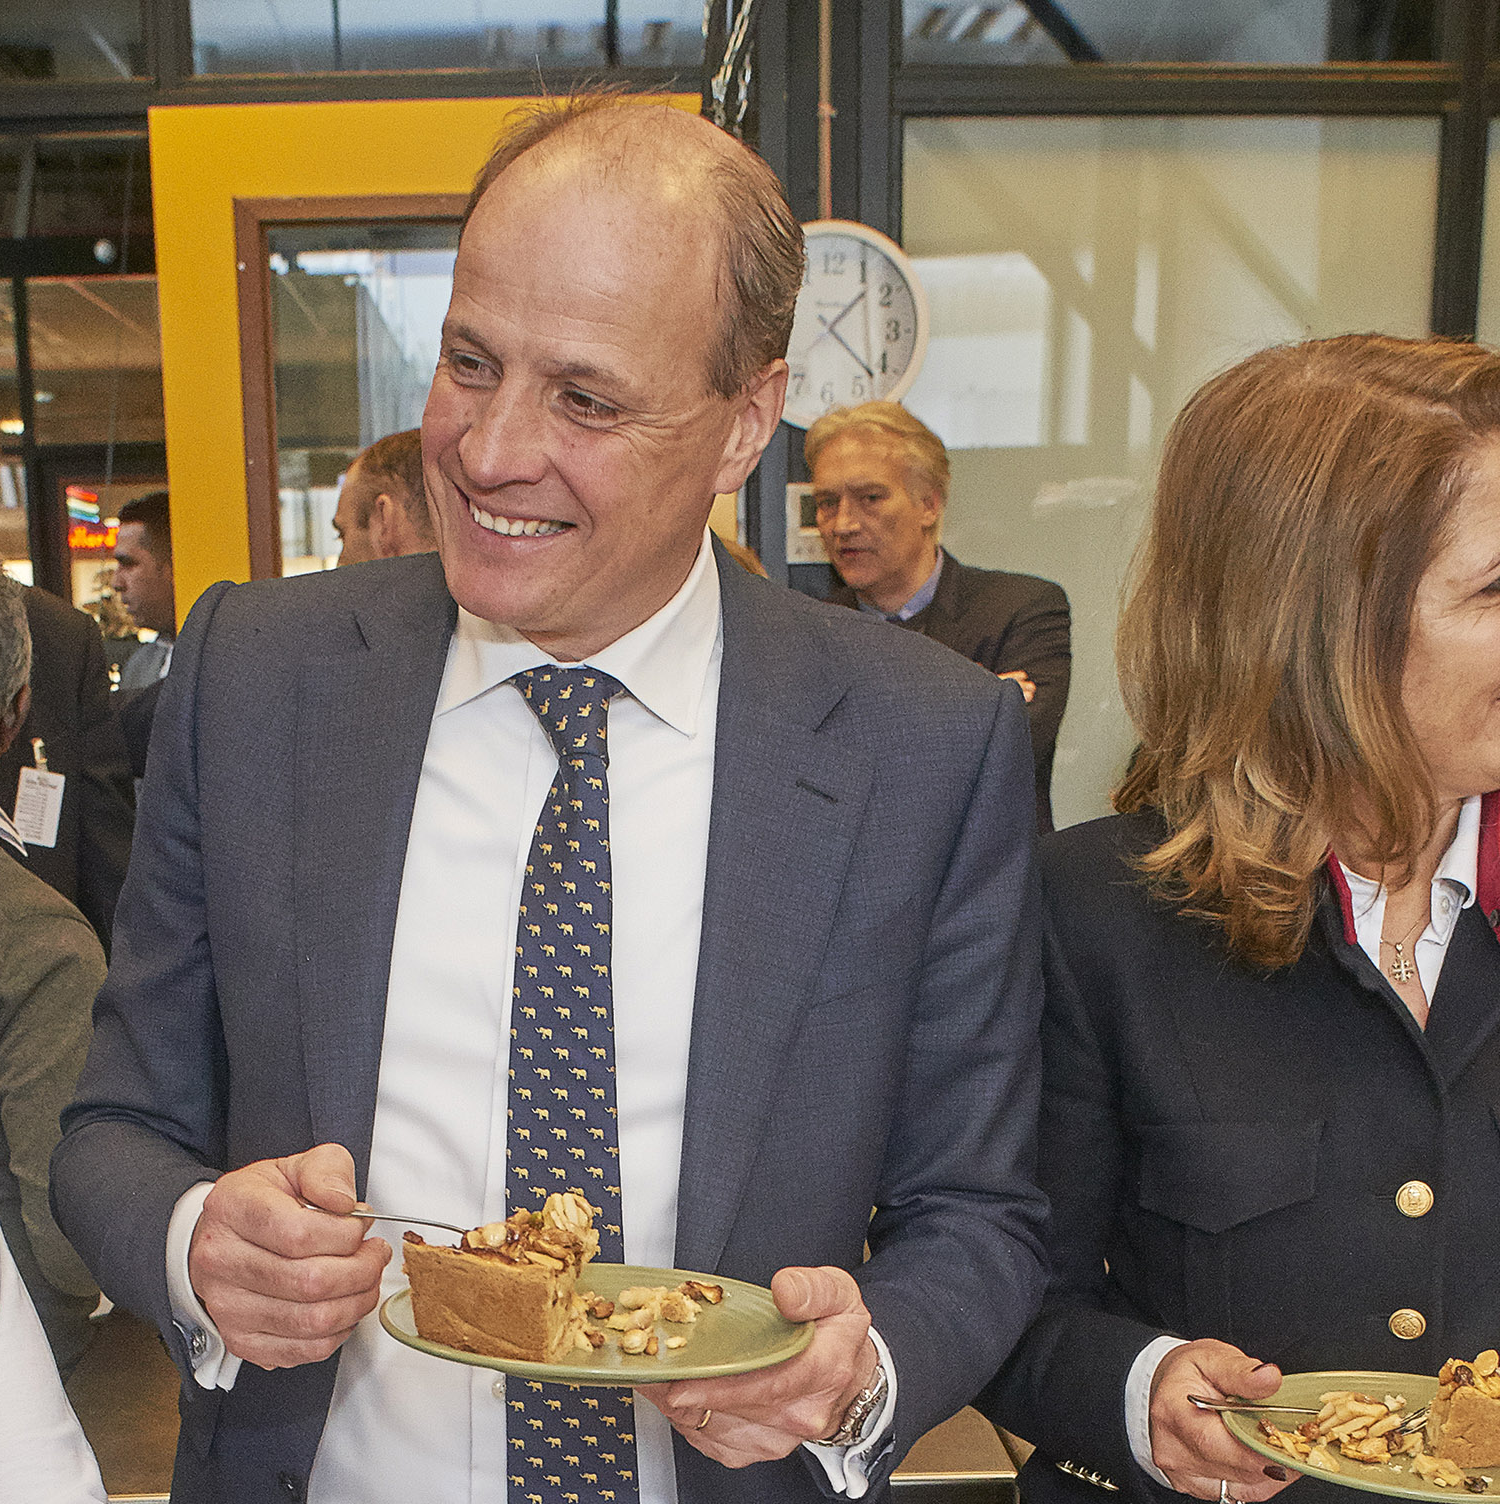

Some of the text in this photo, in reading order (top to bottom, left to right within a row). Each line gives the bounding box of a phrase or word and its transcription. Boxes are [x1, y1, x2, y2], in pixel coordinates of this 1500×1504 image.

[823, 252, 846, 275] 12
[859, 259, 867, 284] 1
[879, 283, 894, 308] 2
[885, 319, 900, 343] 3
[792, 372, 805, 395] 7
[820, 381, 834, 404] 6
[851, 375, 864, 397] 5
